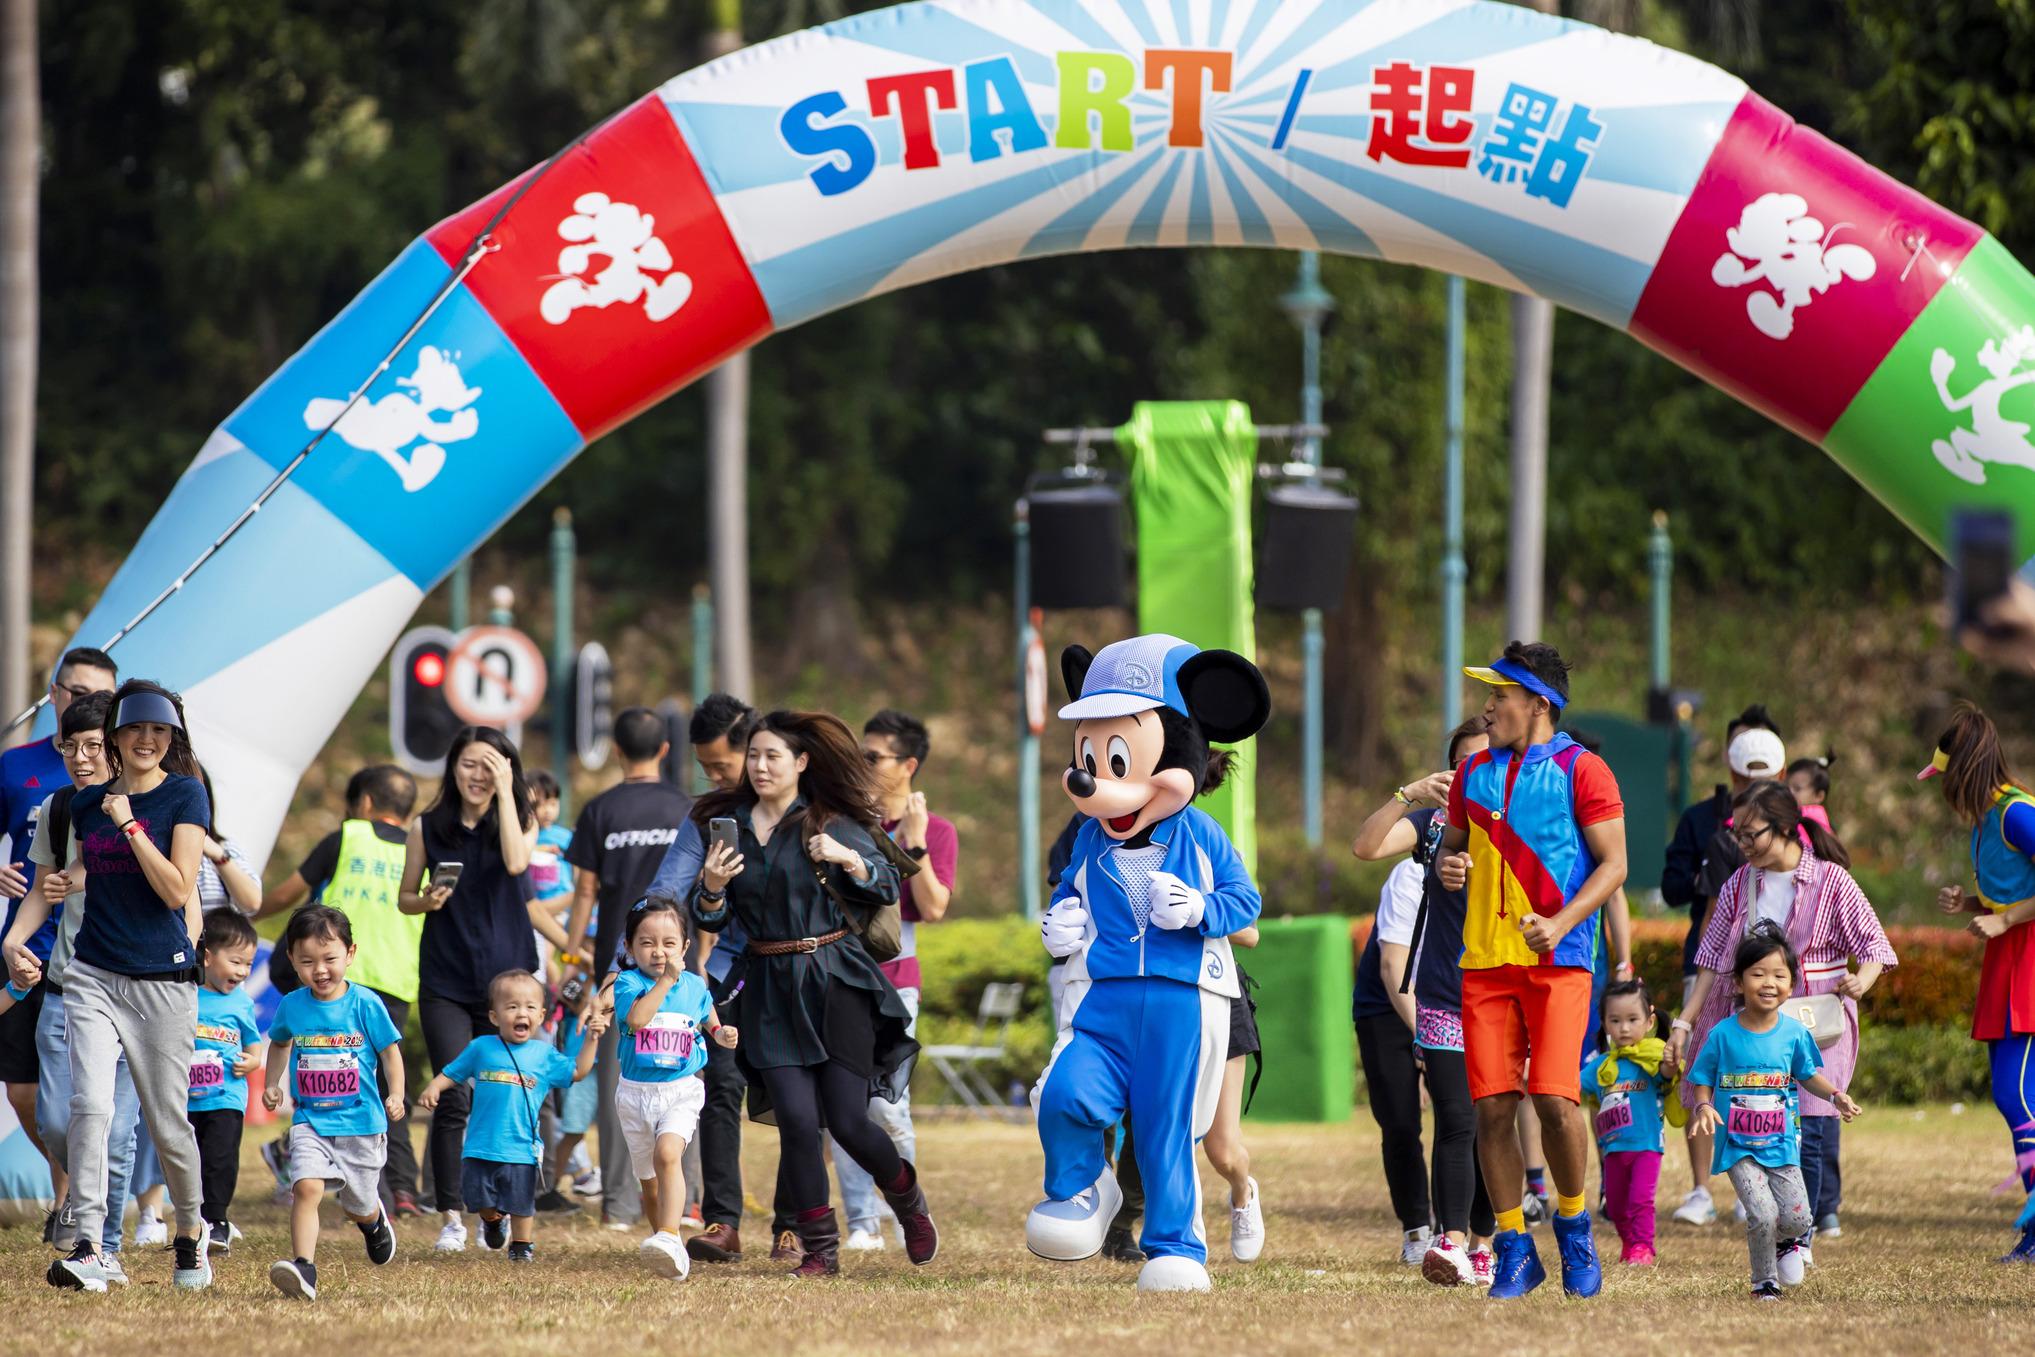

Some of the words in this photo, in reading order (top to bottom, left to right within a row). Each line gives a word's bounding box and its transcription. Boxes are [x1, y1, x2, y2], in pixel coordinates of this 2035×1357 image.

[780, 49, 1232, 196] START
[1367, 61, 1602, 209] 起點
[640, 1030, 692, 1055] K10708
[299, 1072, 357, 1094] K10682
